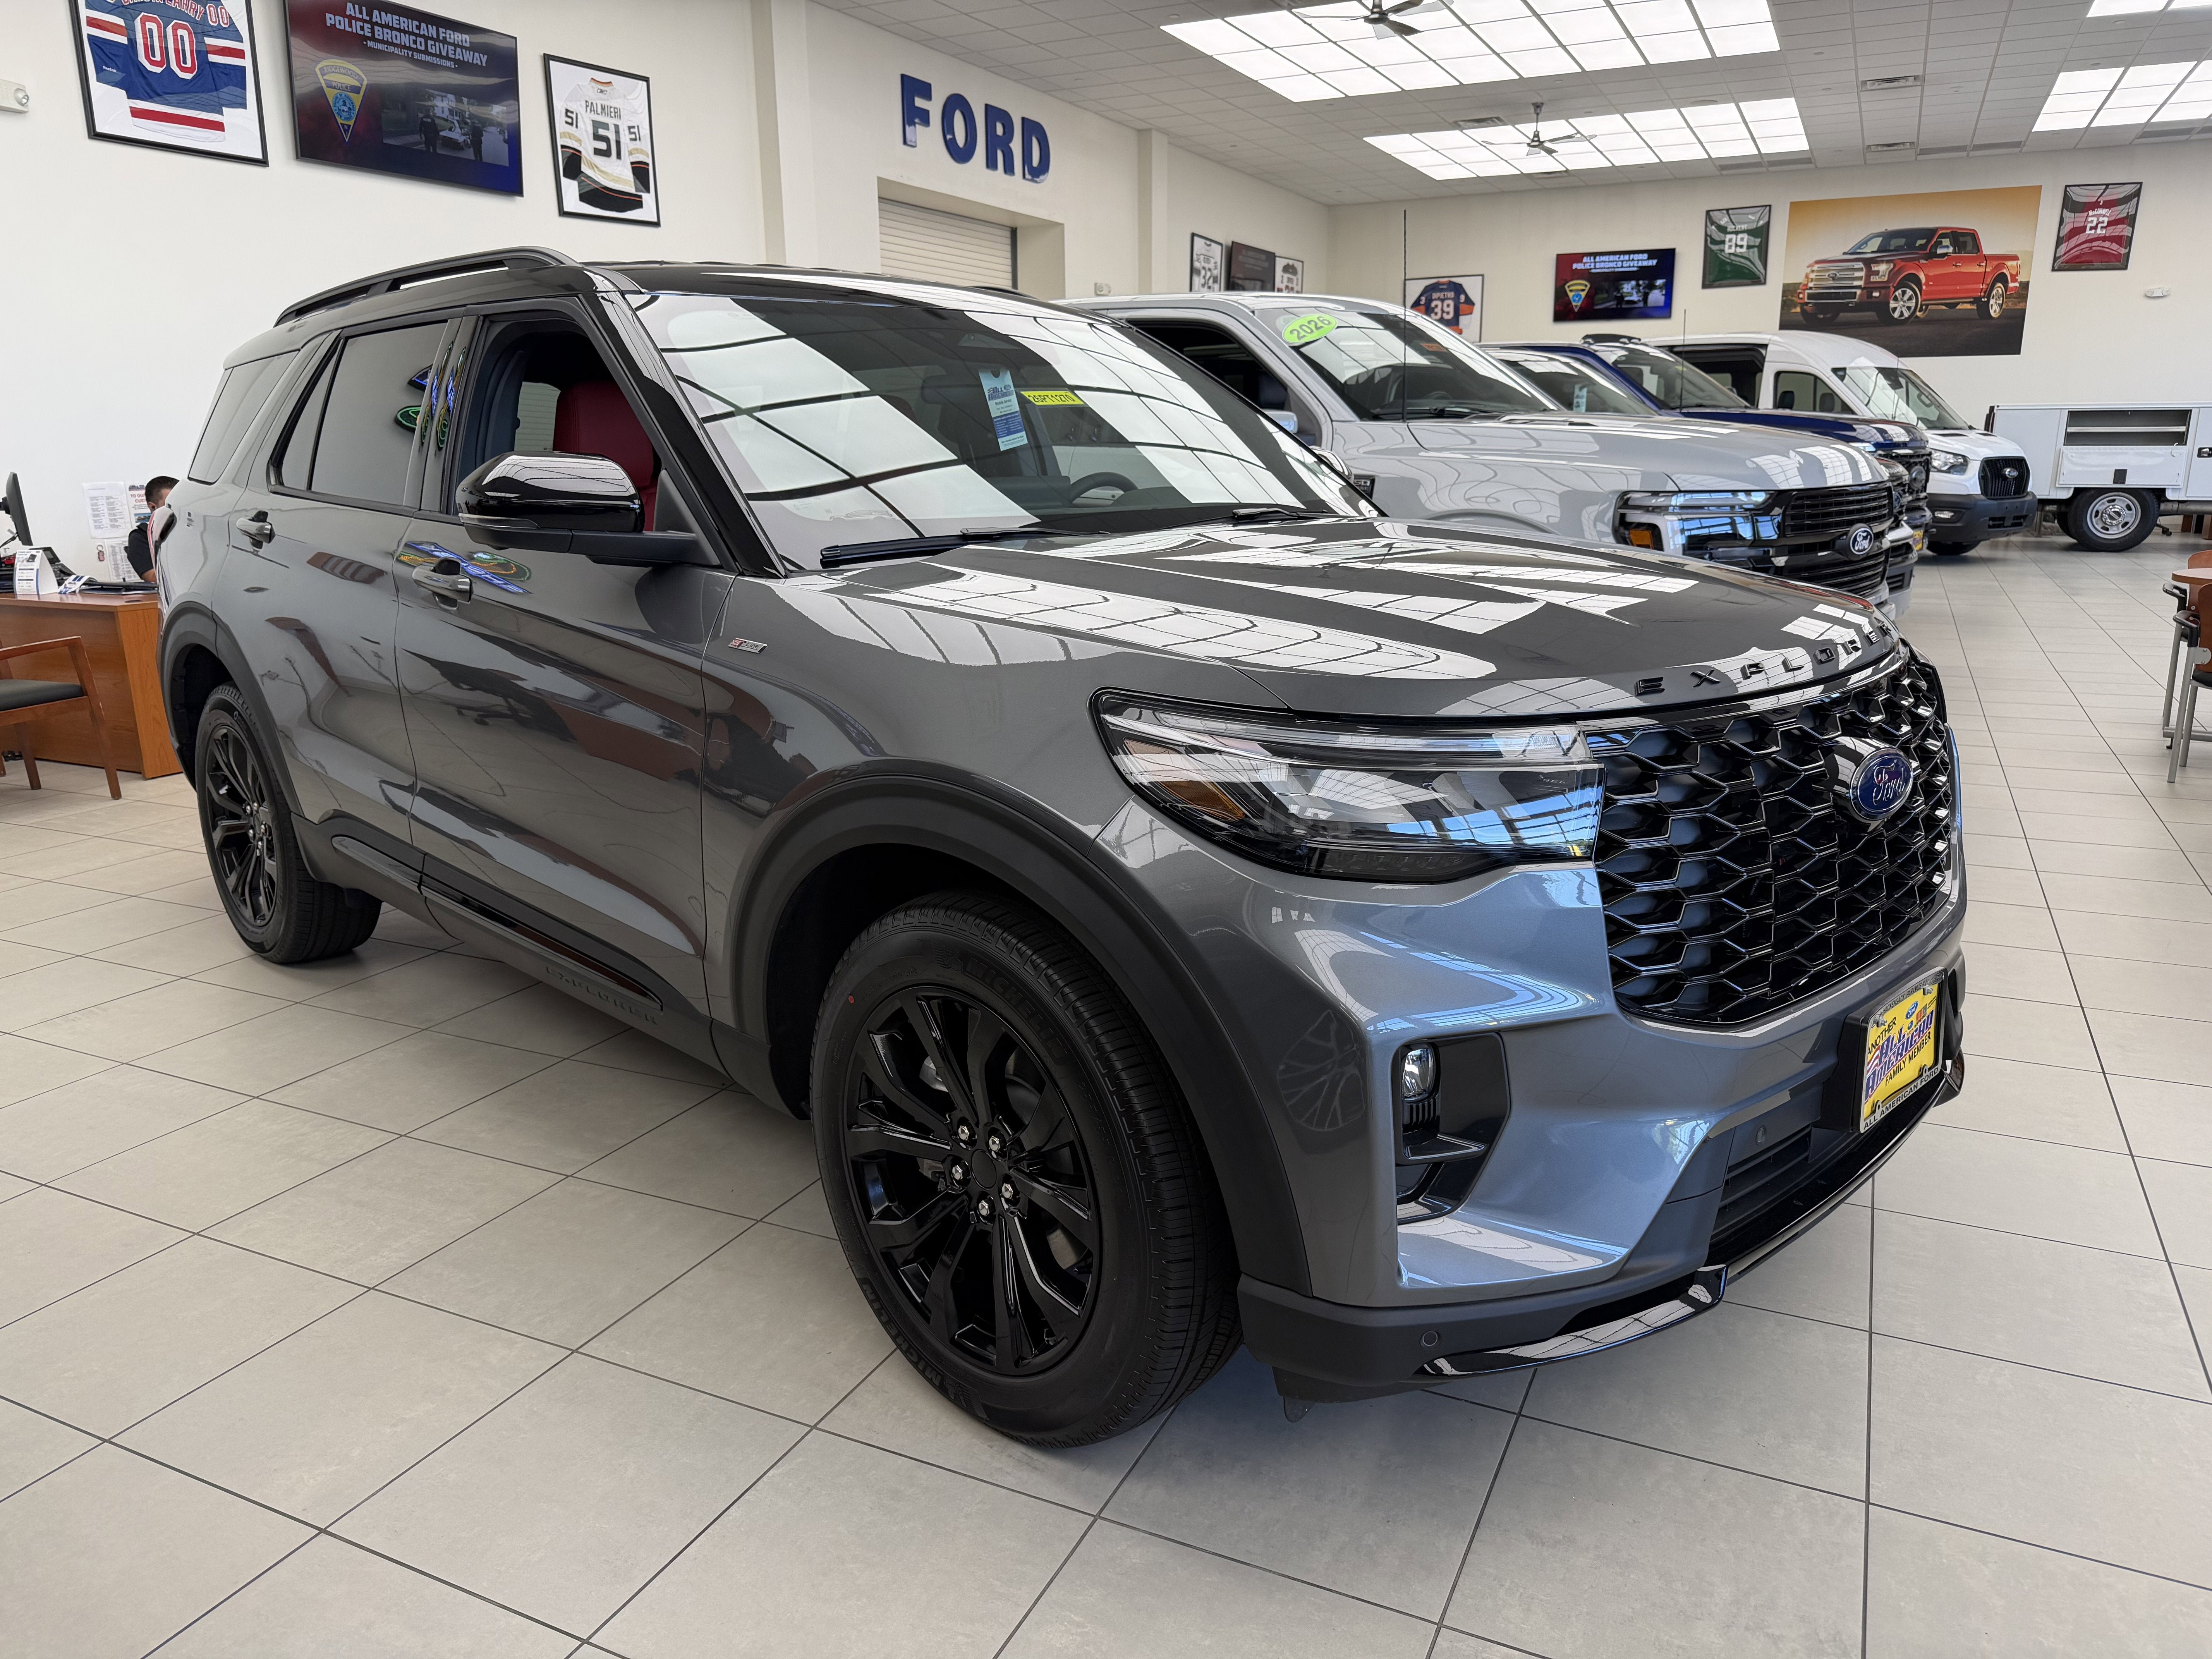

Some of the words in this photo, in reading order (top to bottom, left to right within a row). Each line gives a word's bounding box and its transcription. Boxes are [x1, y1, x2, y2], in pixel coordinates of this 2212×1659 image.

[206, 3, 230, 27] 00
[346, 2, 370, 21] ALL
[372, 9, 437, 39] AMERICAN
[439, 27, 470, 47] FORD
[134, 12, 197, 80] 00
[325, 13, 372, 37] POLICE
[374, 26, 425, 50] BRONCO
[428, 40, 488, 67] GIVEAWAY
[367, 40, 412, 58] MUNICIPALITY
[414, 52, 455, 68] SUBMISSIONS
[323, 66, 358, 79] RIDGEWOOD
[332, 81, 351, 91] POLICE
[565, 108, 578, 129] 51
[585, 100, 621, 120] PALMIERI
[900, 73, 1050, 184] FORD
[591, 119, 622, 160] 51
[627, 125, 641, 142] 51
[1724, 233, 1748, 254] 89
[2086, 217, 2108, 234] 22
[1290, 316, 1332, 341] 2026
[1431, 299, 1454, 320] 39
[1855, 531, 1870, 550] Ford
[1635, 622, 1891, 696] EXPLORER
[1873, 759, 1905, 805] Ford
[965, 957, 1068, 1059] MICHELIN
[1868, 1017, 1896, 1055] ANOTHER
[1879, 1025, 1907, 1065] ALL
[1865, 1010, 1934, 1103] AMERICAN
[1885, 1058, 1906, 1086] FAMILY
[1908, 1031, 1931, 1064] MEMBER
[1864, 1116, 1877, 1130] ALL
[1880, 1082, 1918, 1117] AMERICAN
[1920, 1067, 1938, 1085] FORD
[861, 1283, 942, 1387] MICHELIN
